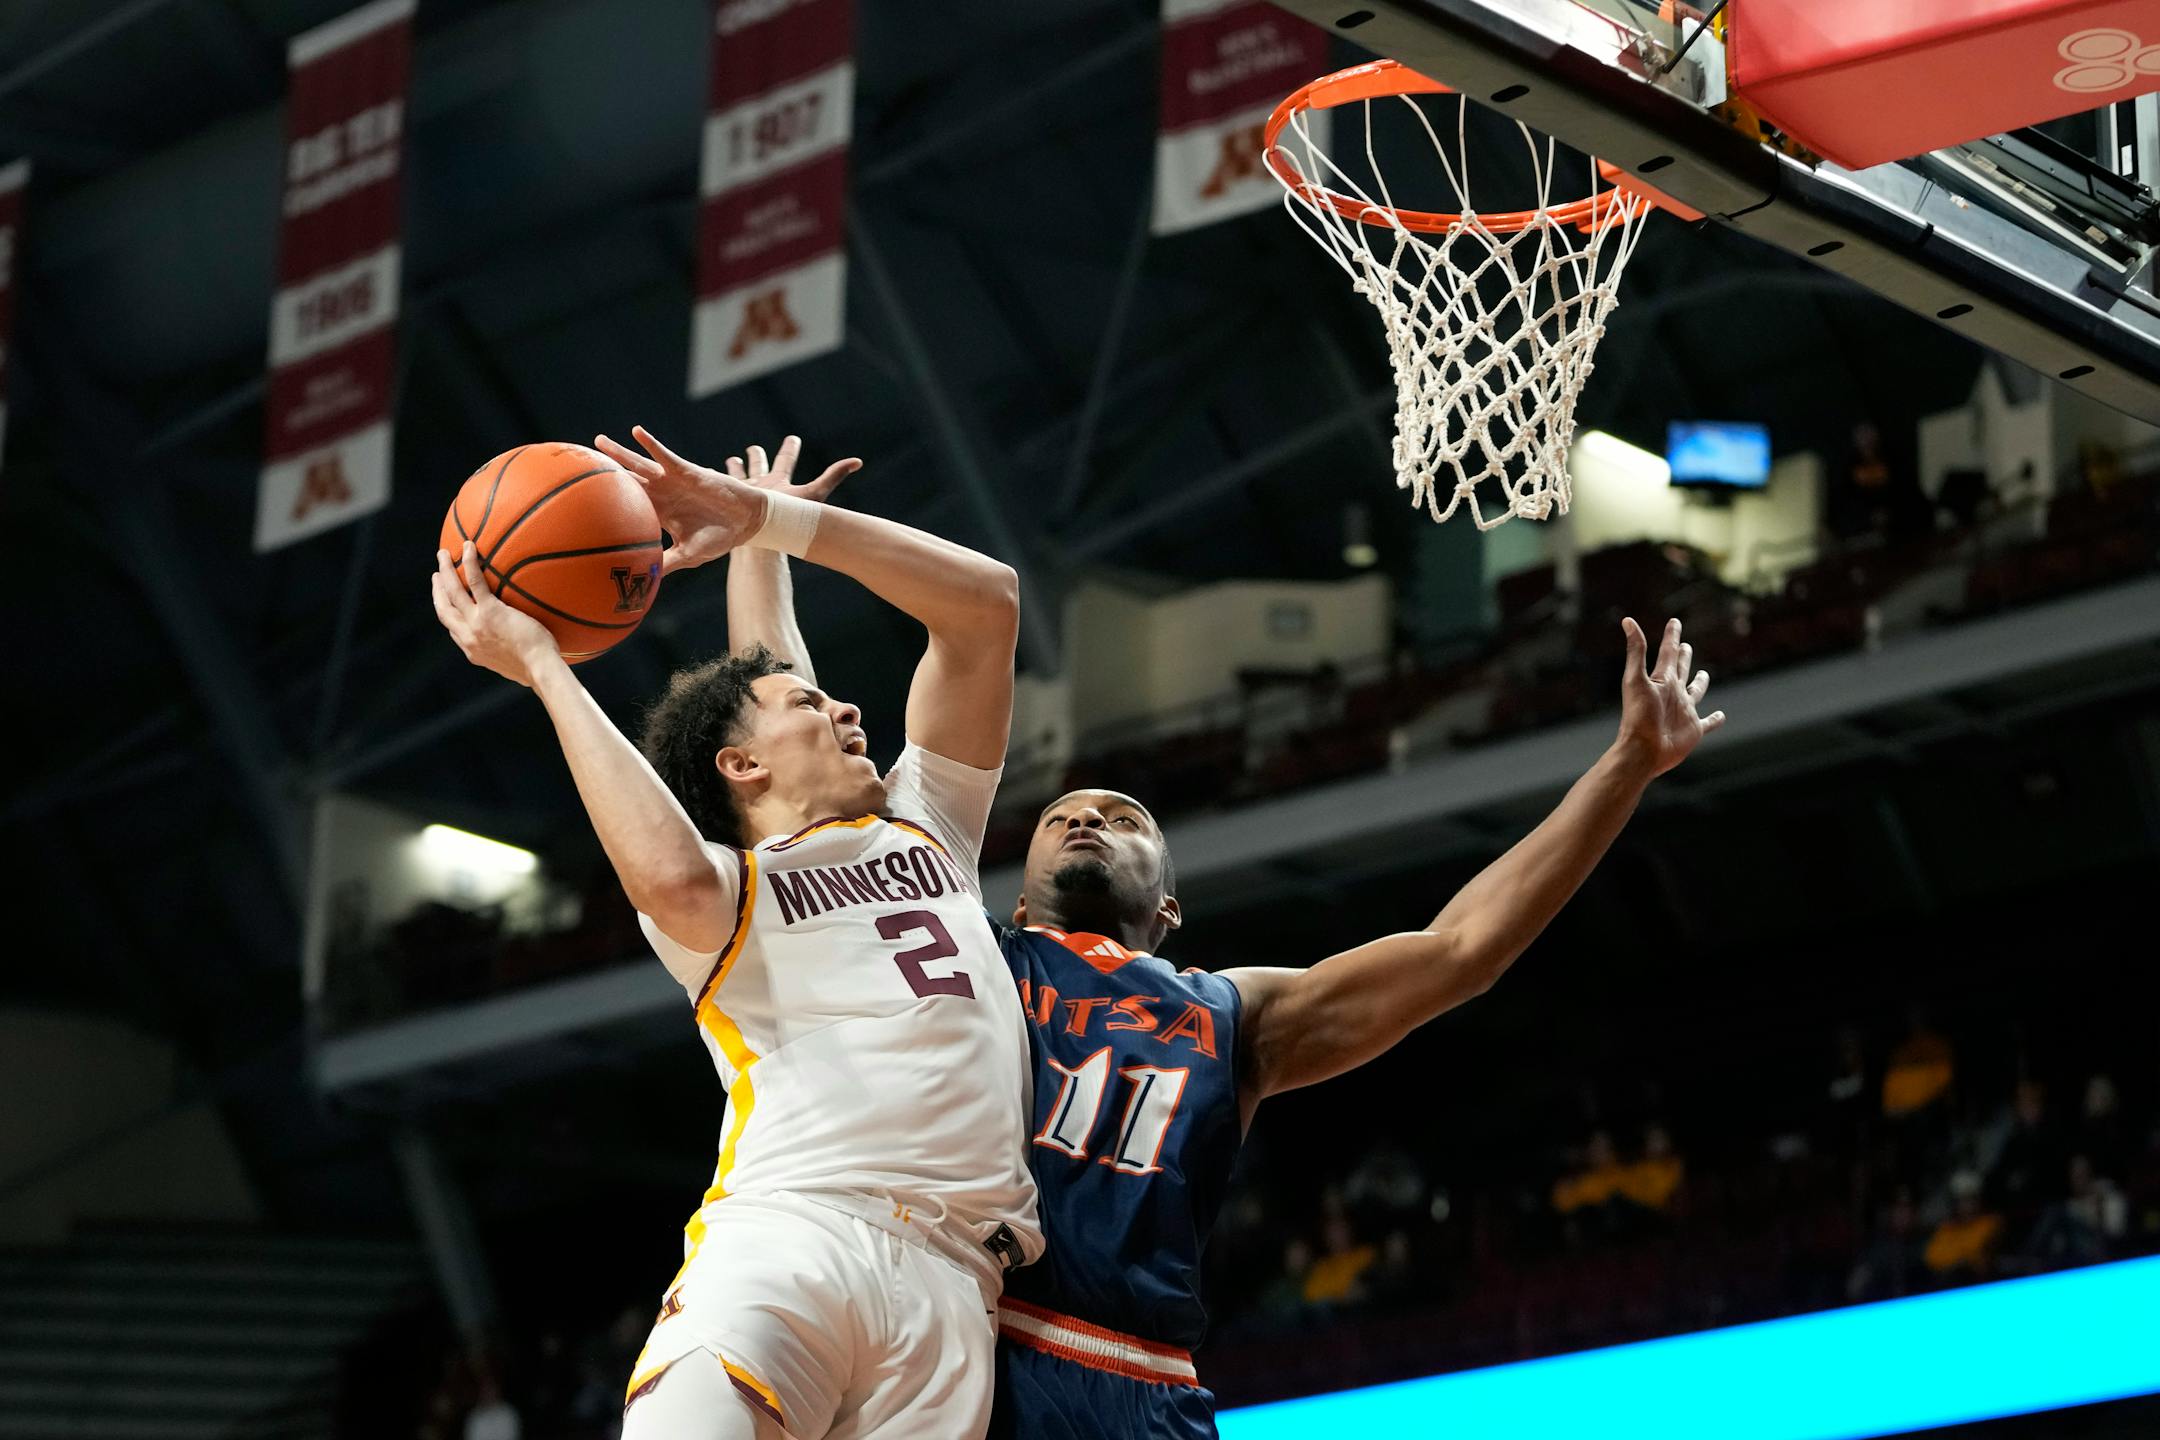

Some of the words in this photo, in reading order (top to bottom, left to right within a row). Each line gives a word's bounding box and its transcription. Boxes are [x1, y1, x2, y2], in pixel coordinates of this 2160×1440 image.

[874, 910, 976, 1000] 2
[1018, 978, 1218, 1060] UTSA
[1032, 1046, 1191, 1176] 11
